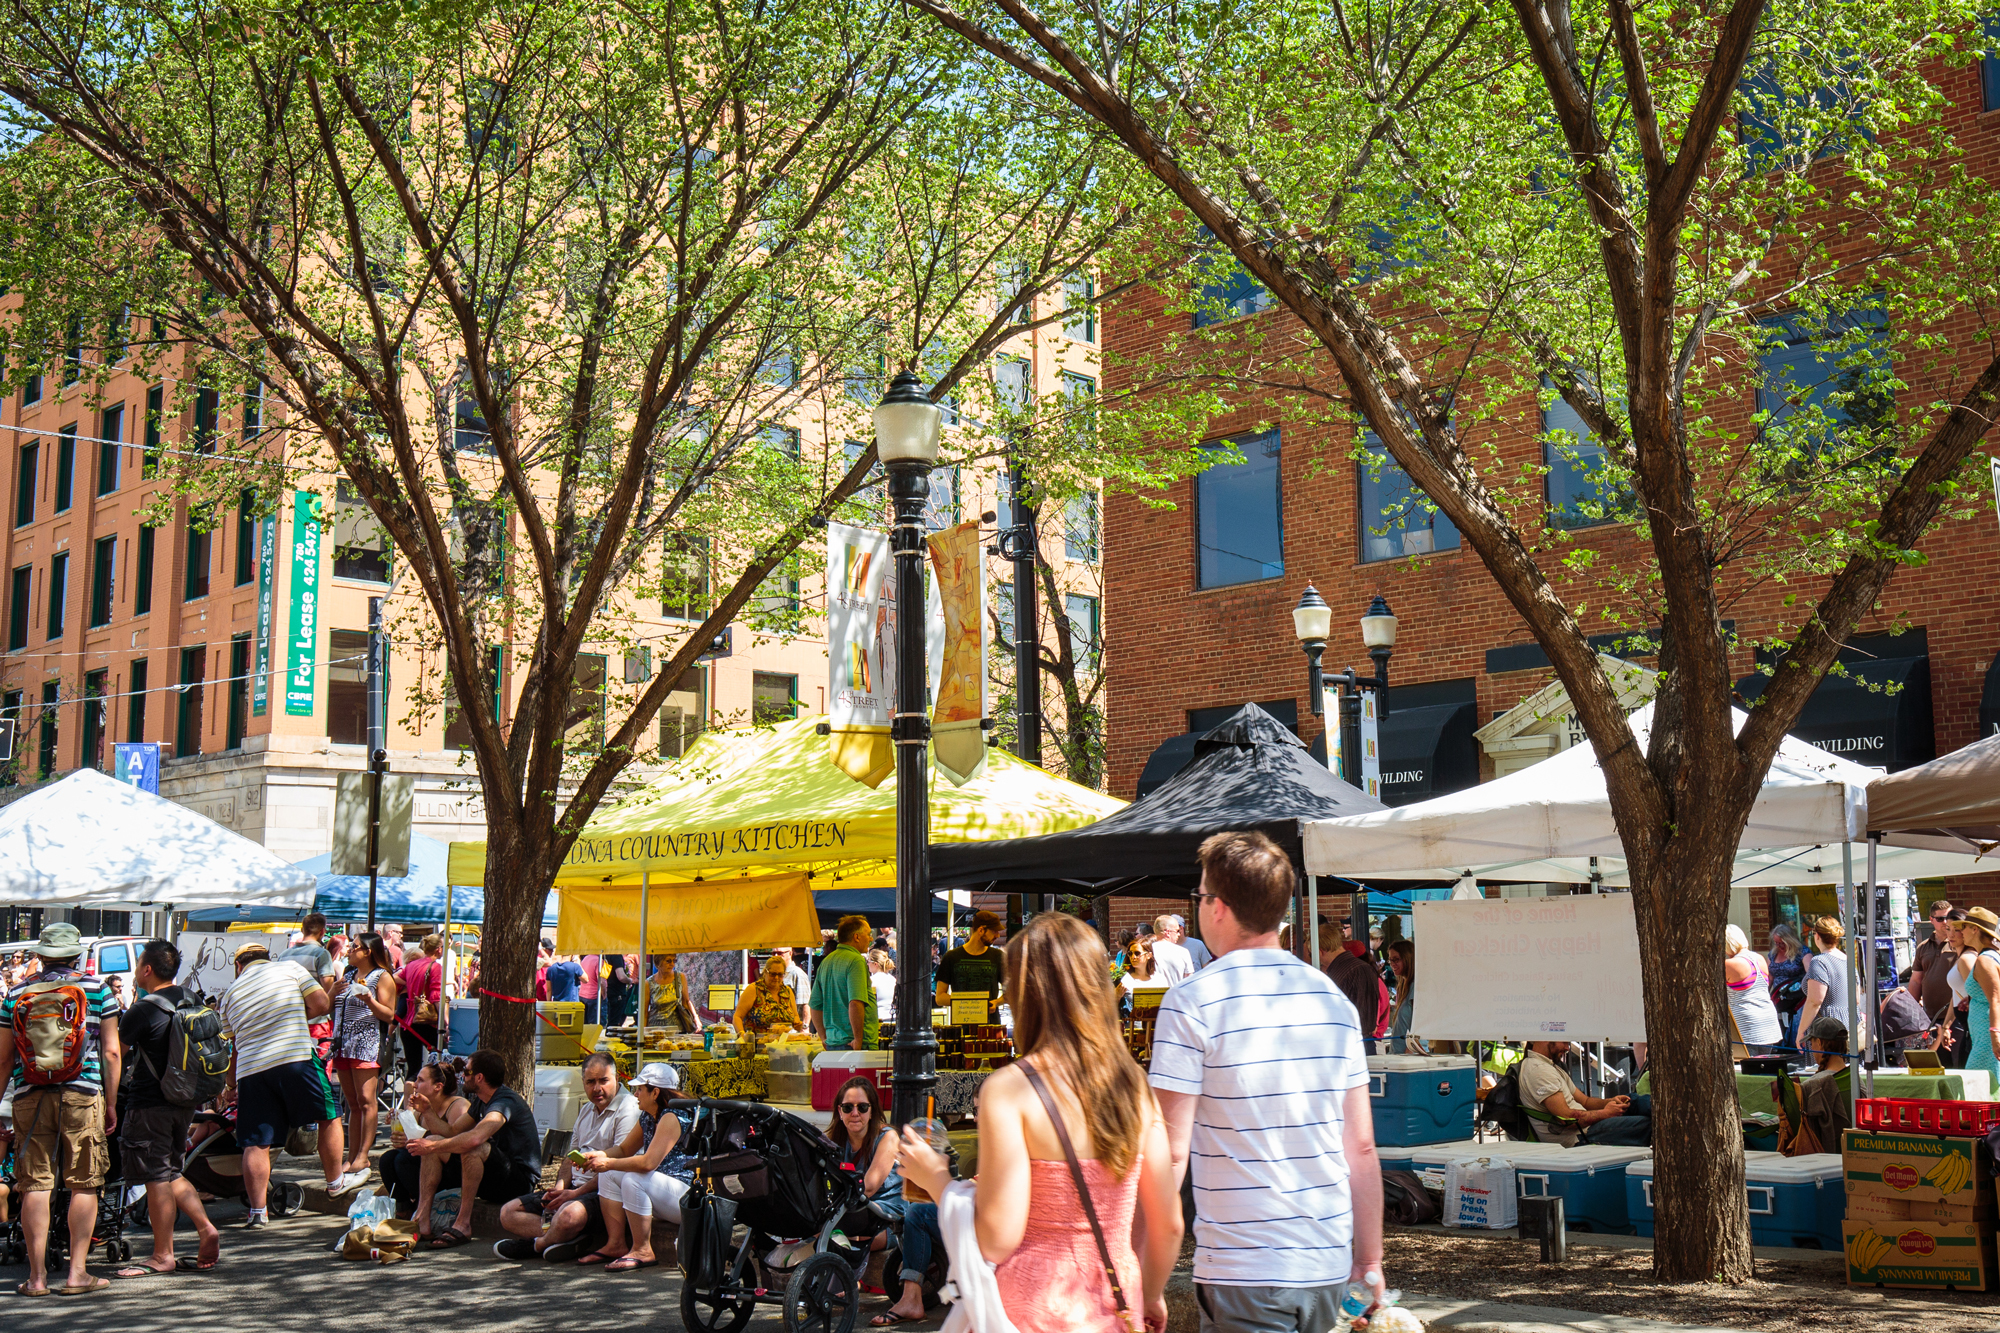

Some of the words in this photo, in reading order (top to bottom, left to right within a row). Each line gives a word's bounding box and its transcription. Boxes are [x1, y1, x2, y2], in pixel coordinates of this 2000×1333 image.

[304, 522, 317, 556] 5475
[295, 543, 304, 562] 780
[304, 559, 316, 586] 424
[259, 591, 270, 649] Lease
[296, 591, 314, 649] Lease
[258, 654, 267, 687] For
[294, 654, 311, 687] For
[254, 692, 266, 701] CBRE
[288, 692, 312, 701] CBRE
[845, 696, 878, 708] STREET
[1378, 770, 1424, 784] VILDING
[414, 802, 458, 818] ILLON
[620, 830, 726, 860] COUNTRY
[732, 820, 850, 853] KITCHEN
[1854, 1138, 1896, 1150] PREMIUM
[1898, 1142, 1942, 1154] BANANAS
[1885, 1171, 1894, 1180] Del
[1896, 1172, 1917, 1182] Monte
[1460, 1194, 1474, 1204] big
[1458, 1212, 1475, 1221] low
[1461, 1204, 1487, 1216] fresh,
[1900, 1240, 1921, 1248] Monte
[1922, 1240, 1933, 1248] Del
[1878, 1268, 1923, 1280] BANANAS
[1926, 1270, 1970, 1281] PREMIUM
